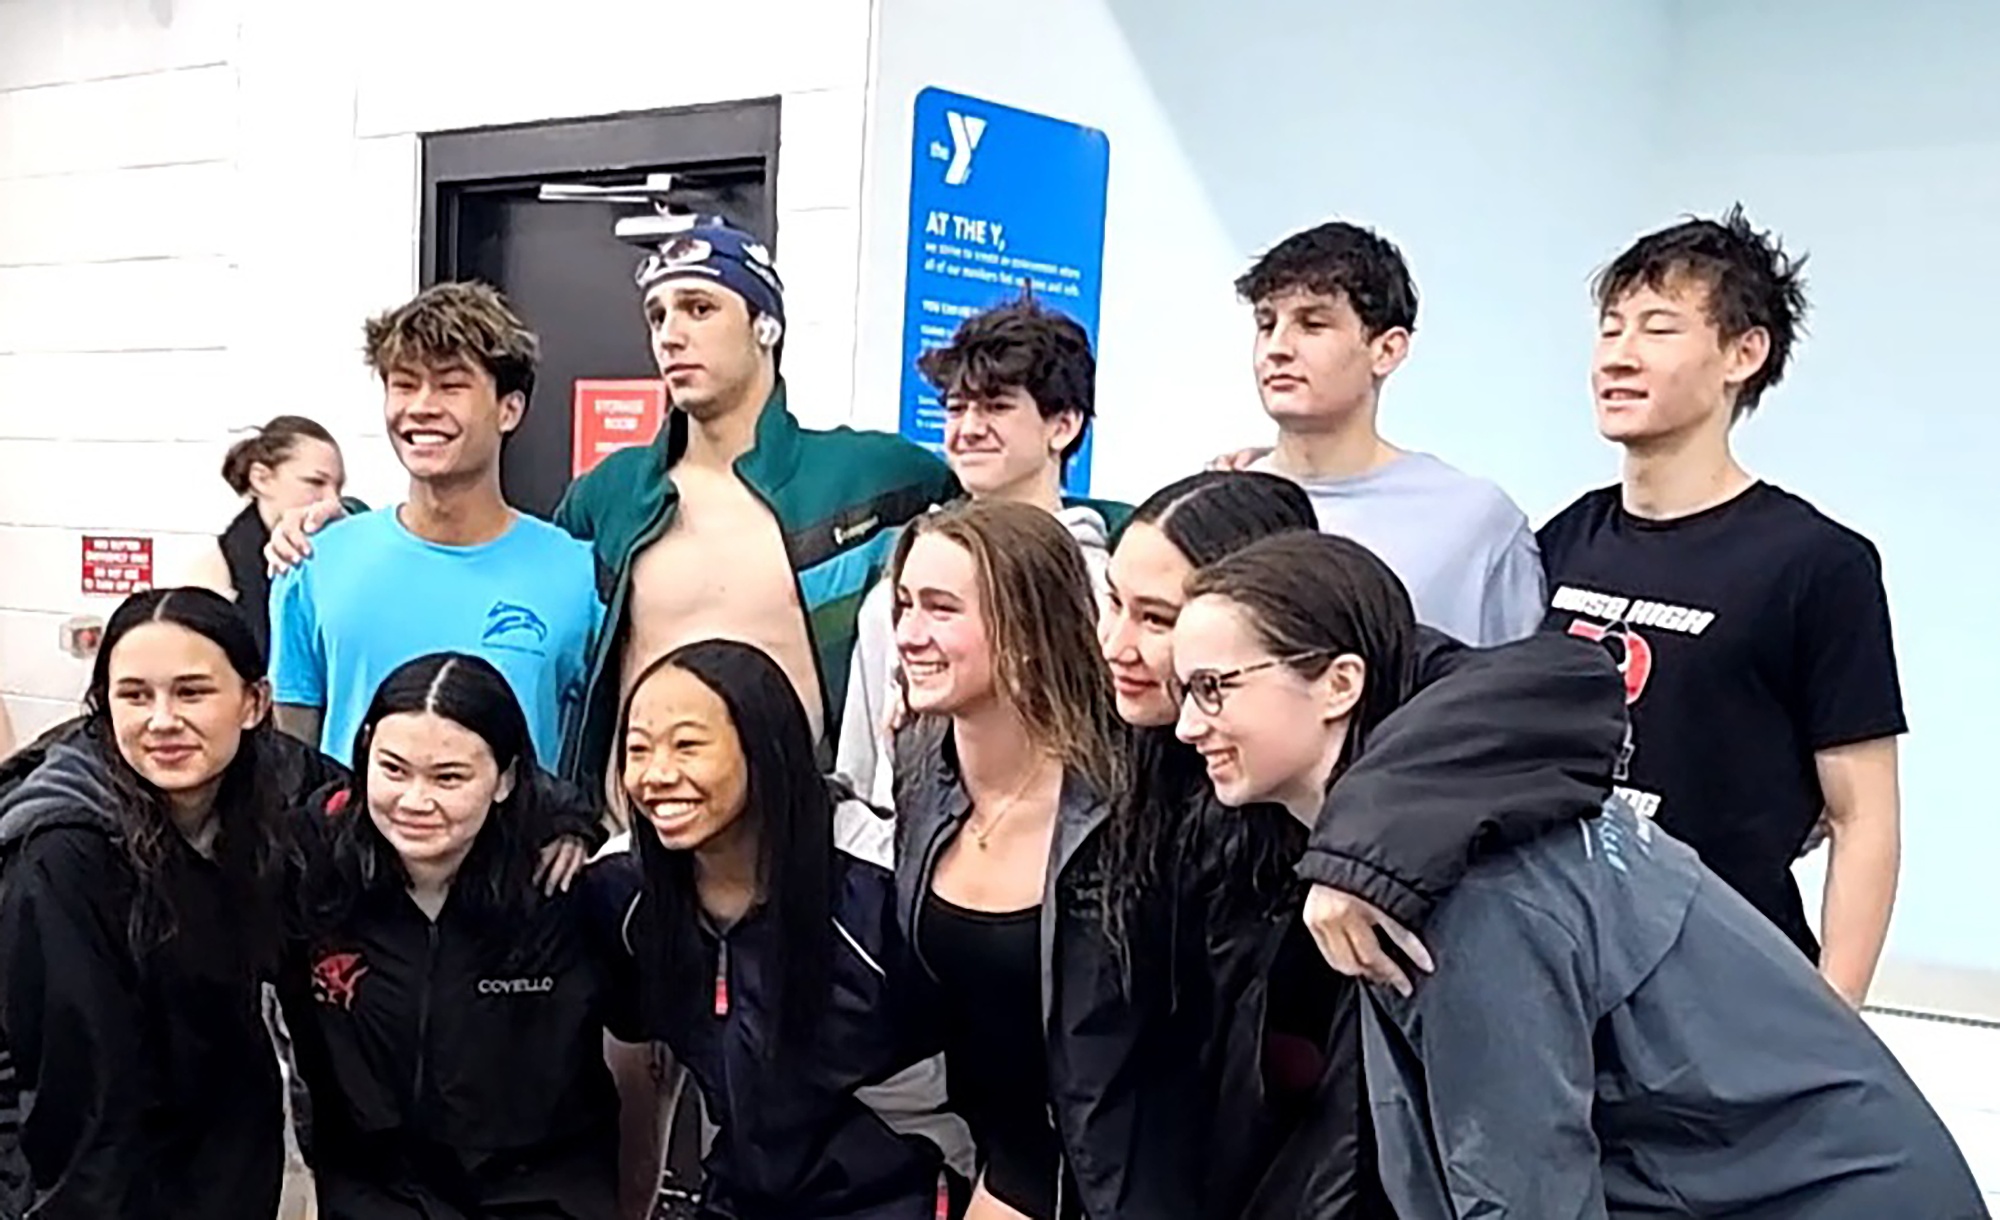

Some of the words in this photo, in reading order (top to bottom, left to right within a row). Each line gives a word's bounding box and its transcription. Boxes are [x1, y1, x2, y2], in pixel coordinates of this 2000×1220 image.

[945, 109, 988, 185] Y
[925, 210, 950, 236] AT
[952, 214, 986, 244] THE
[1625, 599, 1716, 635] HIGH
[478, 976, 554, 994] COVELLO
